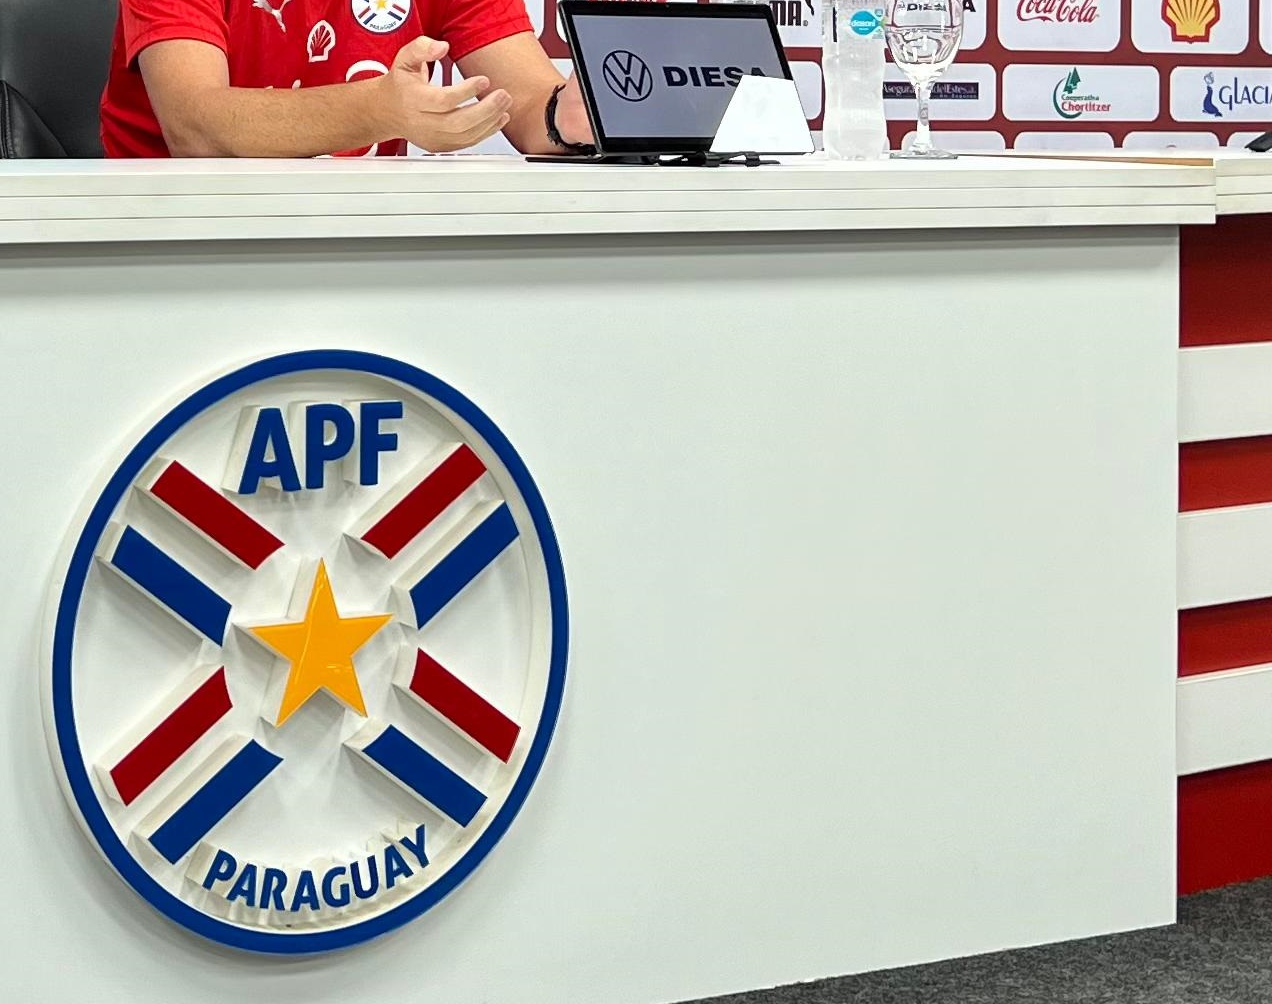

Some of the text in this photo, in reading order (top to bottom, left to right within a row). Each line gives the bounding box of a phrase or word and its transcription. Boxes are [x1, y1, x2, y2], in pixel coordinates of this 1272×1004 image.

[1061, 101, 1111, 112] Chortitzer
[1218, 77, 1272, 111] GLACI
[238, 401, 403, 495] APF
[202, 823, 429, 912] PARAGUAY
